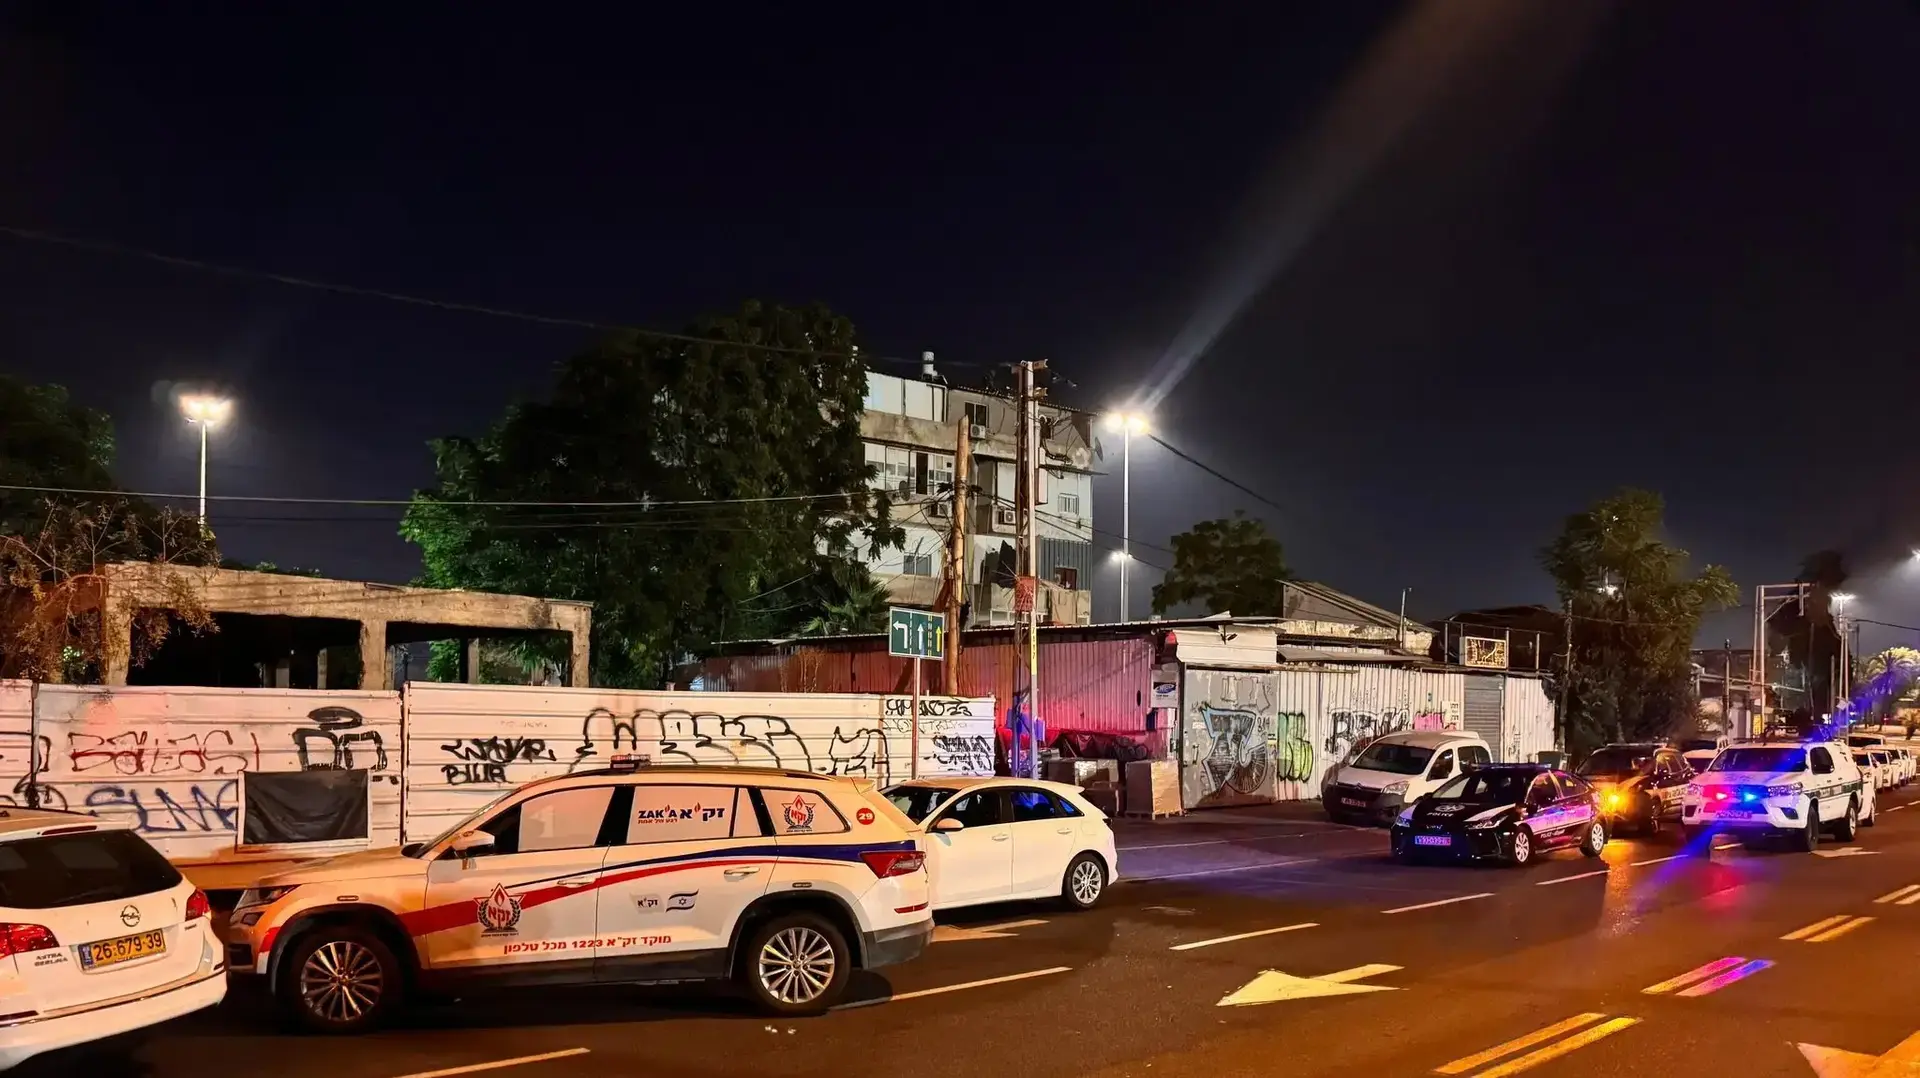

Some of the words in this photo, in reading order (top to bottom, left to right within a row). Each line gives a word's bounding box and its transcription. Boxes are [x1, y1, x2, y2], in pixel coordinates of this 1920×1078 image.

[859, 812, 873, 820] 29
[571, 939, 603, 949] 1223
[641, 935, 672, 946] מוקד
[503, 943, 539, 955] טלפון
[542, 941, 567, 951] מכל
